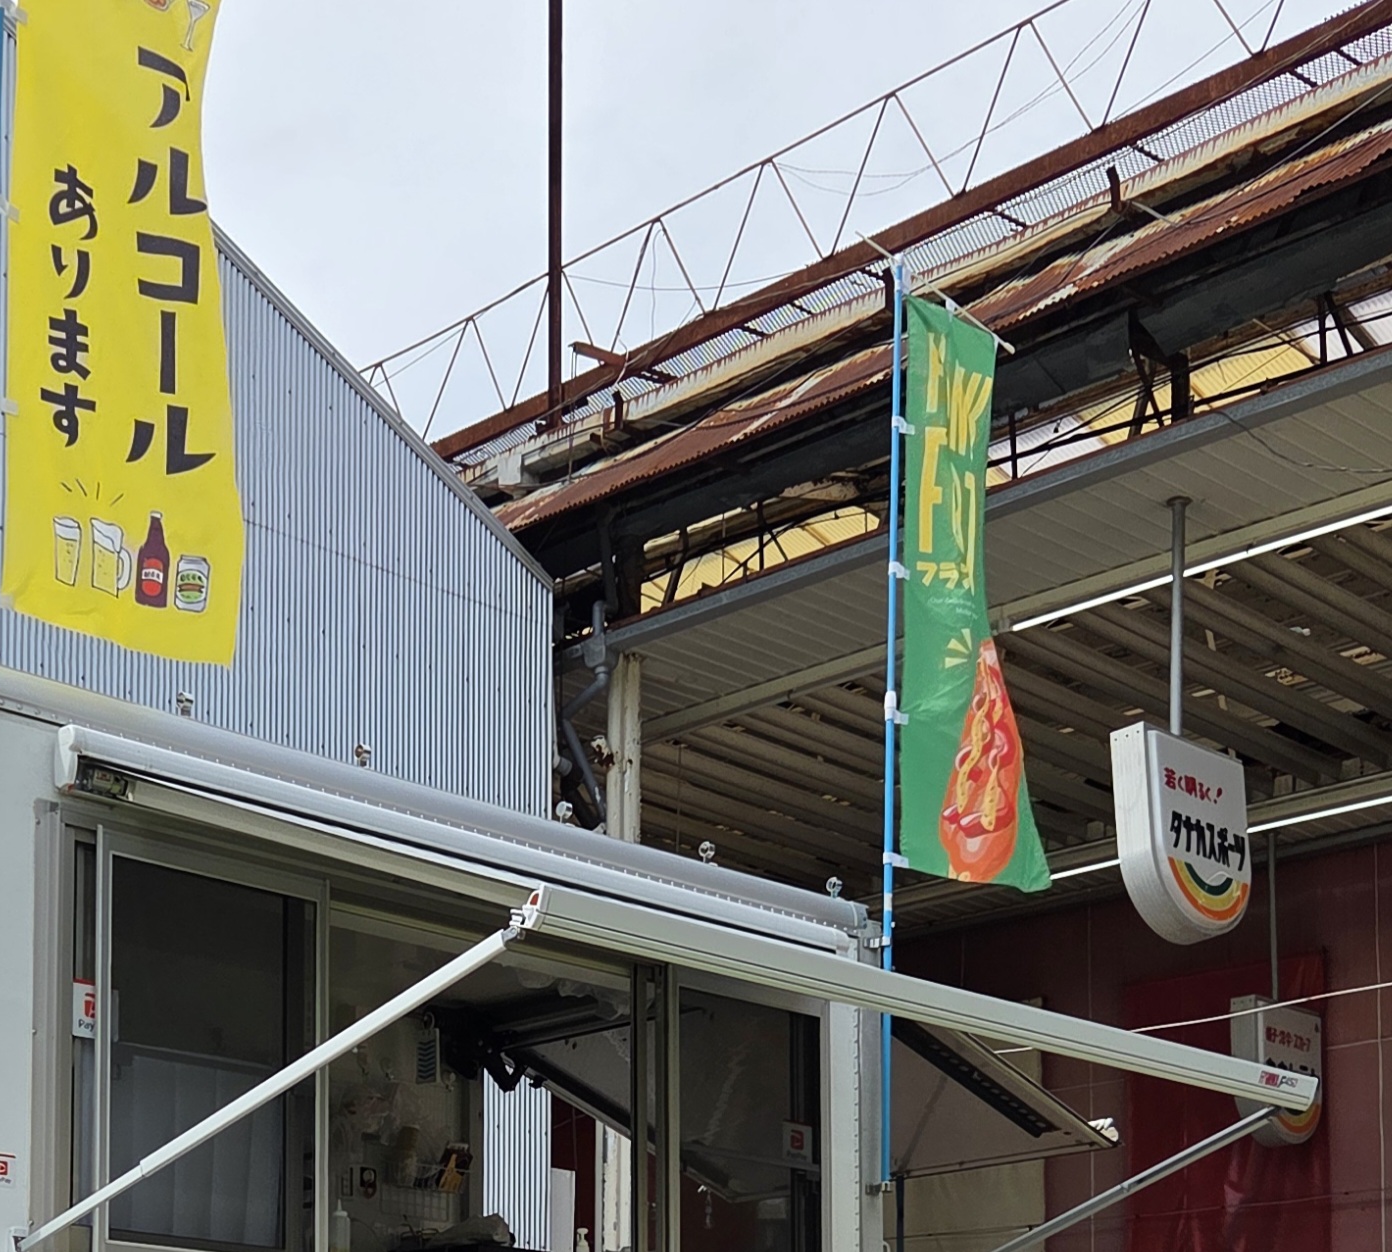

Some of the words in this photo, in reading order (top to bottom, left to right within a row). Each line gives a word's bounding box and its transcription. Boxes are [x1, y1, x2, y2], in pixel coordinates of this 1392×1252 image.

[40, 164, 98, 447] あります
[127, 46, 216, 475] アルコール
[1170, 810, 1246, 872] タナカスポーツ
[78, 1019, 96, 1031] Pay
